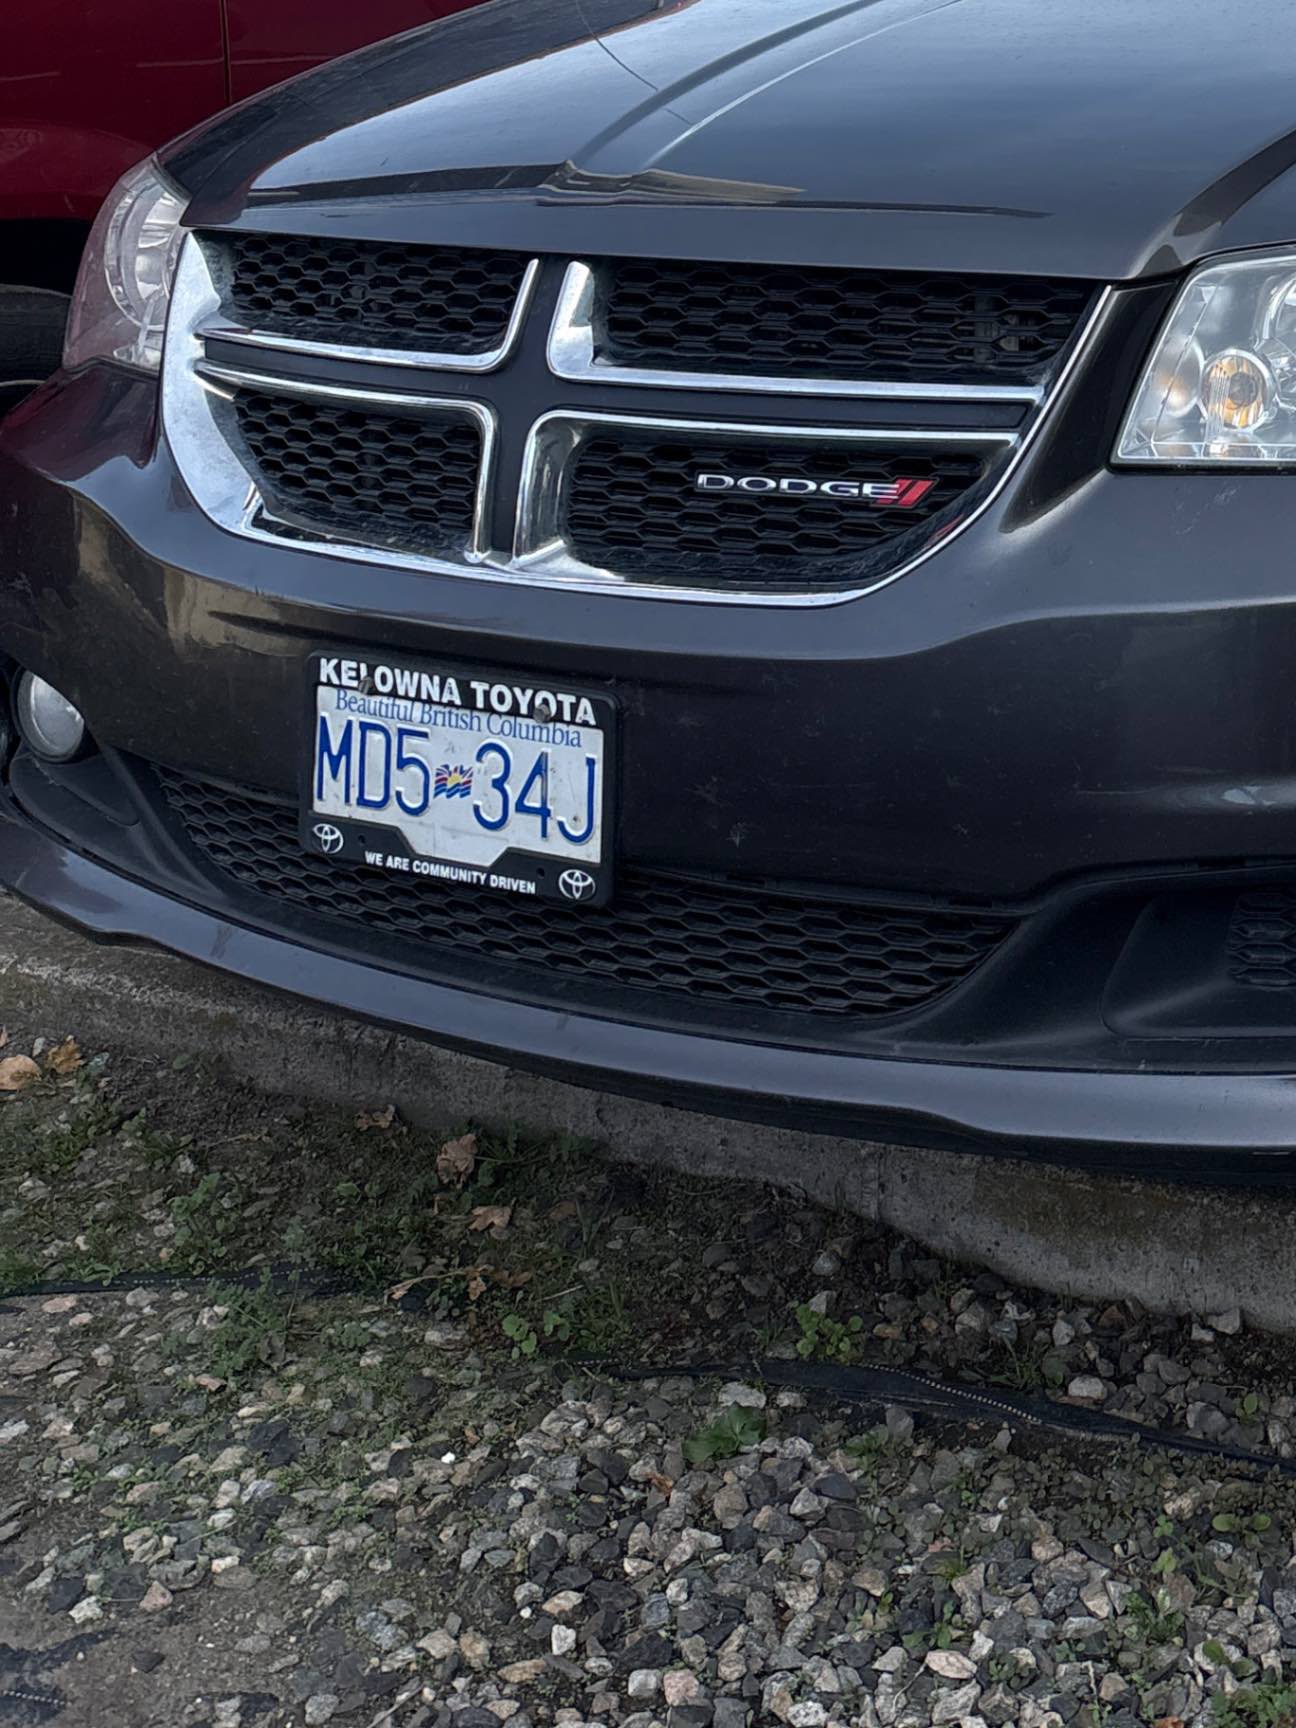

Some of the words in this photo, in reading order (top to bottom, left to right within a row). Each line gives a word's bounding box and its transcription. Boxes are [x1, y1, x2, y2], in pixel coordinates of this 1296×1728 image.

[697, 474, 901, 499] DODGE
[336, 689, 415, 723] Beautiful
[419, 705, 482, 732] British
[486, 715, 582, 748] Columbia
[470, 681, 597, 726] TOYOTA
[317, 715, 431, 817] MD5
[472, 741, 597, 845] 34J
[364, 851, 385, 868] WE
[386, 854, 411, 871] ARE
[412, 860, 488, 887] COMMUNITY
[489, 874, 537, 895] DRIVEN
